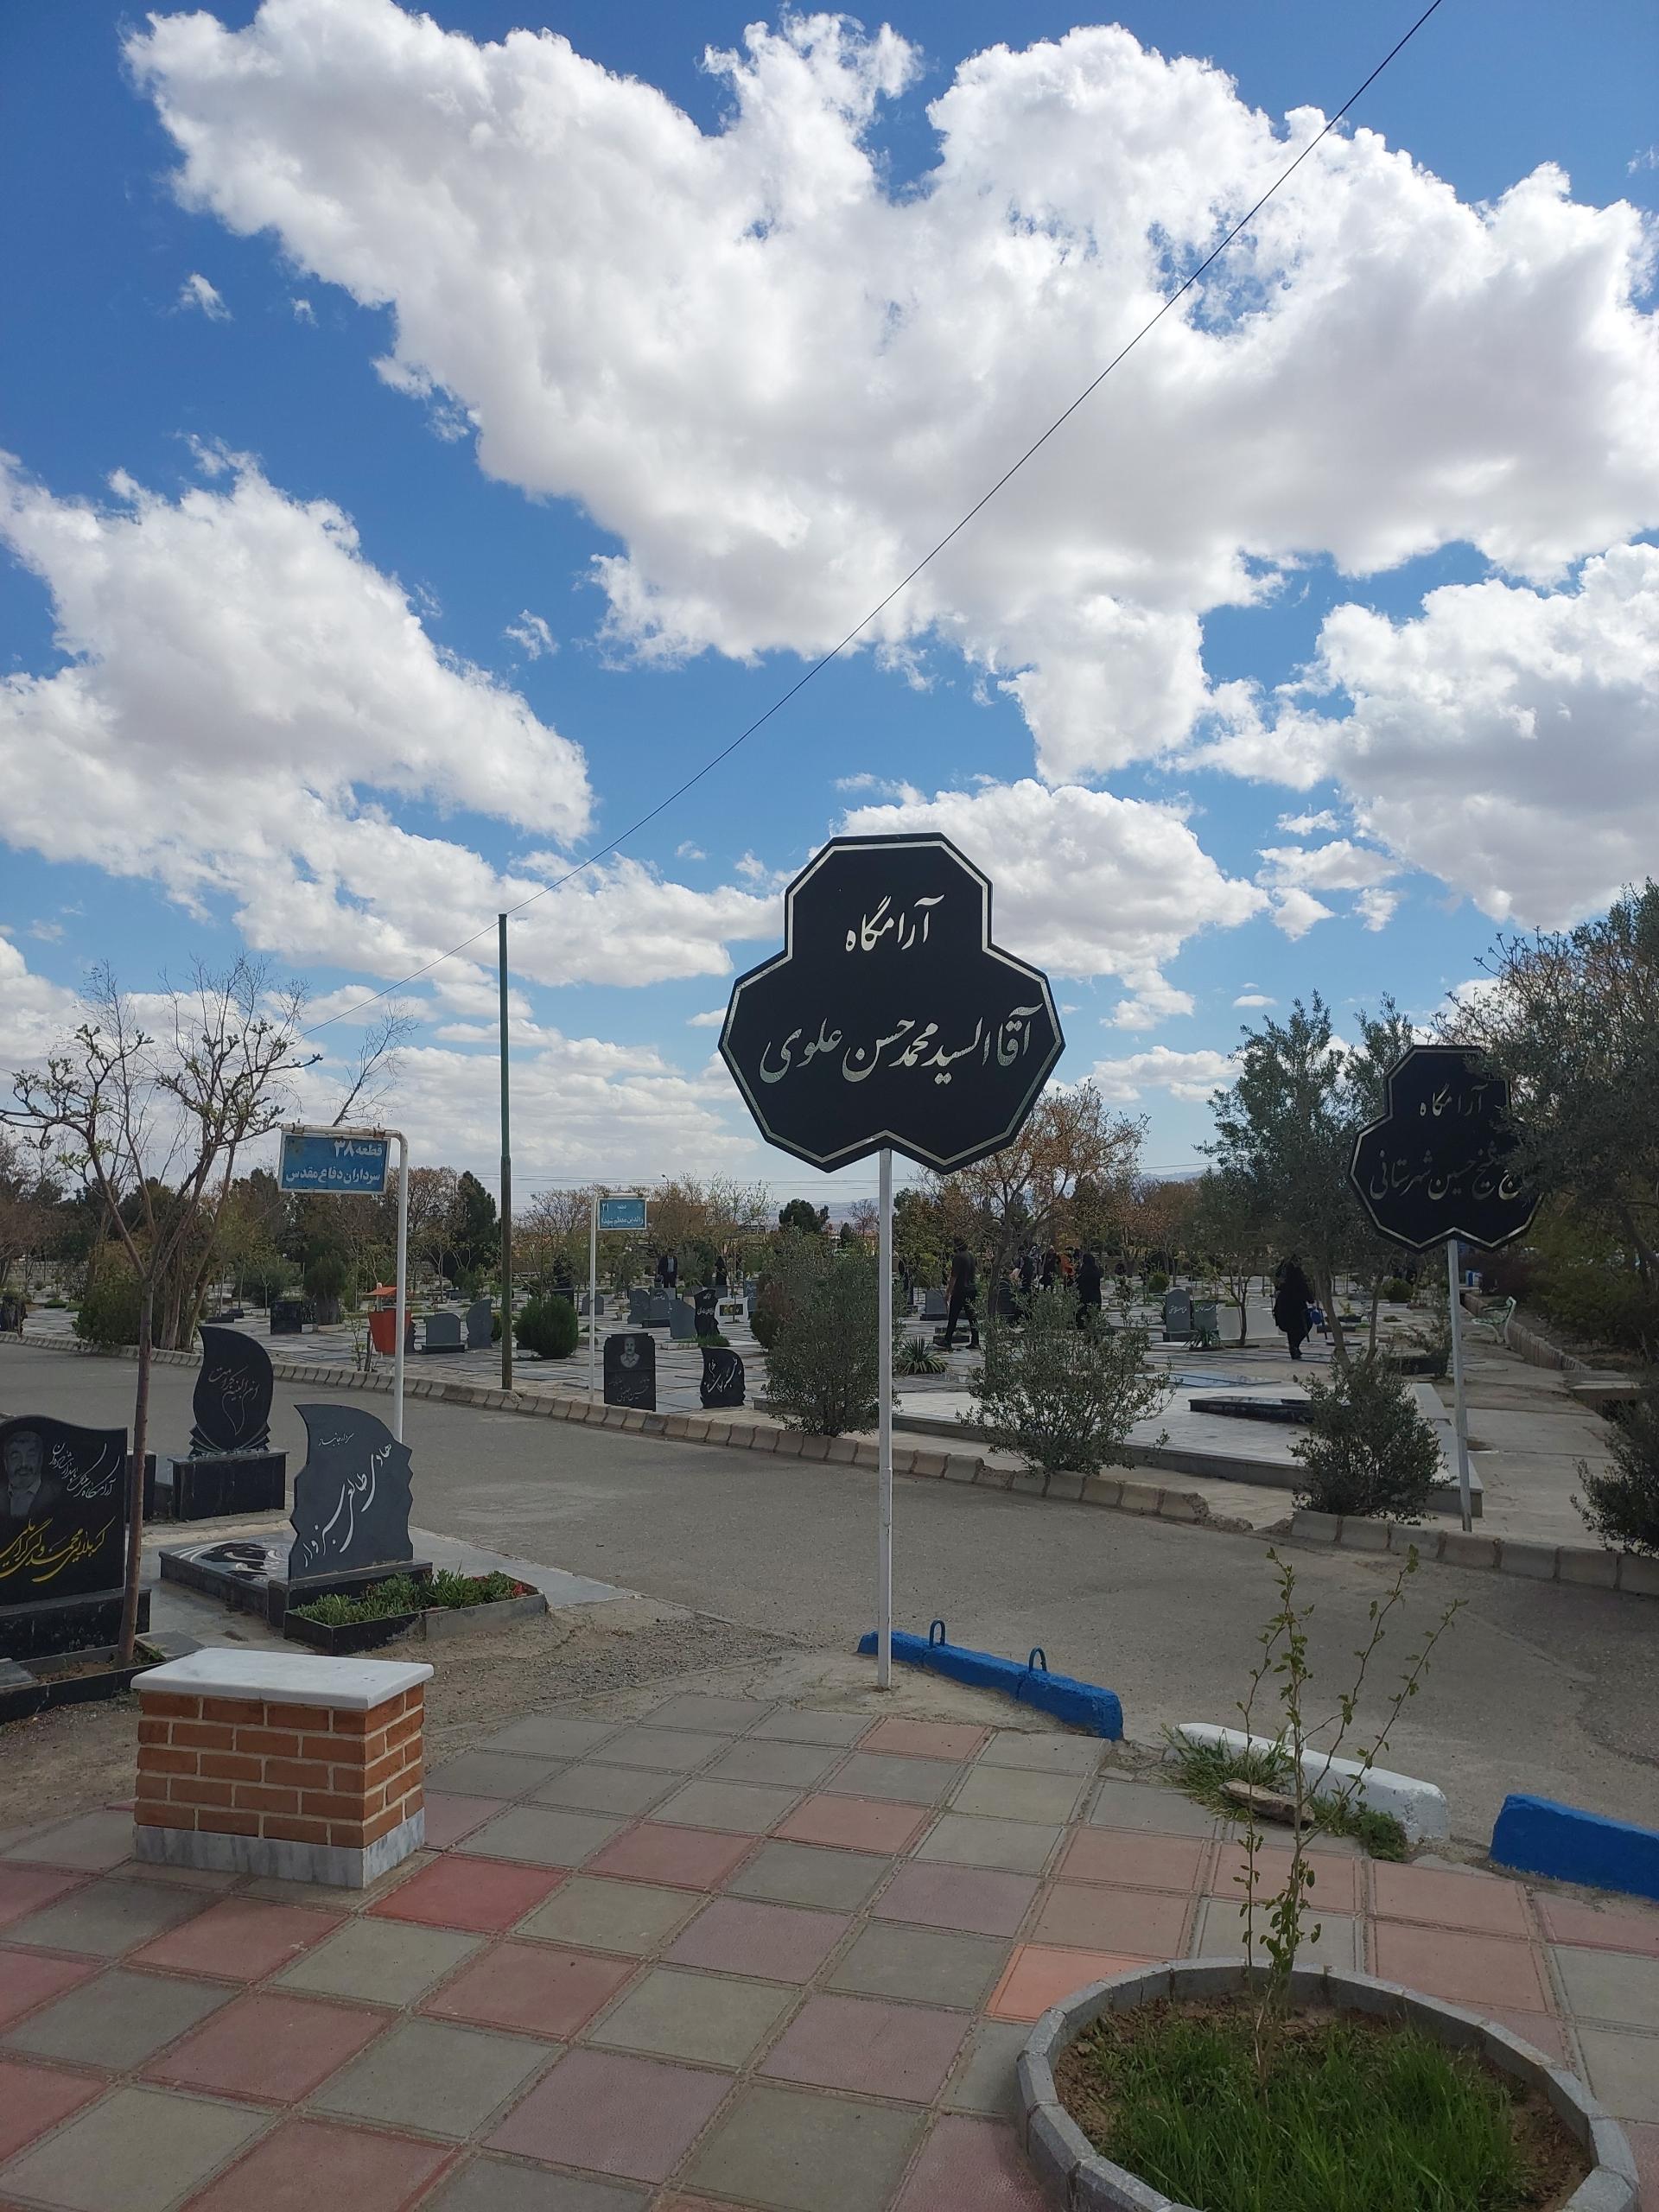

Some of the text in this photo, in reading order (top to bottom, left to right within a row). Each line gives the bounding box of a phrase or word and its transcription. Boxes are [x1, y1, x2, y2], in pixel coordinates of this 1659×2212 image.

[845, 893, 945, 951] آرامگاه
[759, 1002, 1044, 1085] آقا السید محمد حسن علوی
[1419, 1083, 1489, 1116] آرامگاه
[355, 1143, 383, 1156] قطعه
[285, 1166, 381, 1185] سرداران دفاع مقدس
[1427, 1159, 1475, 1200] حسین
